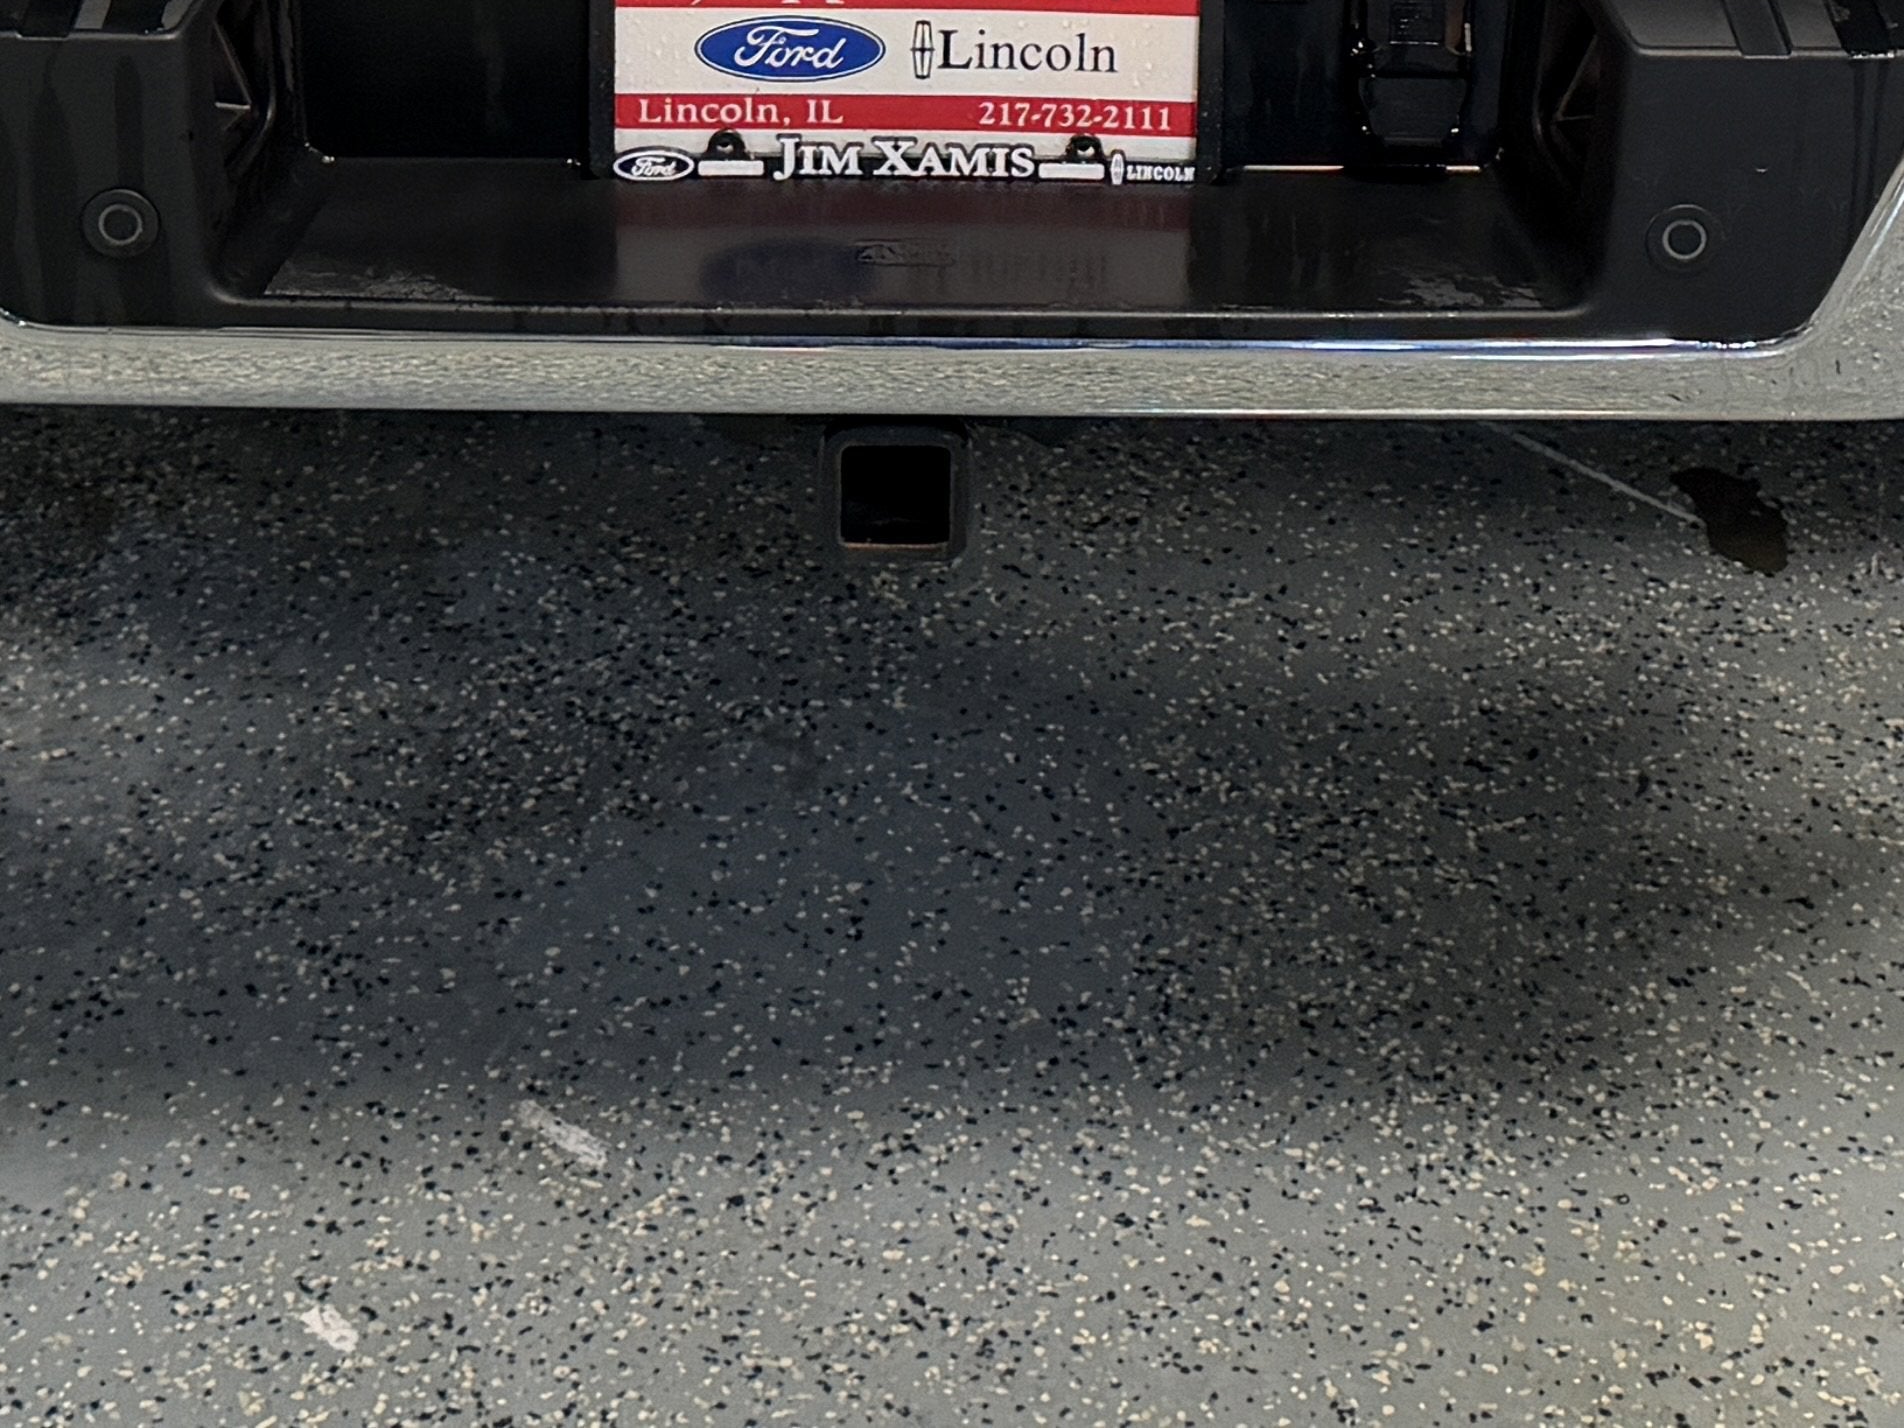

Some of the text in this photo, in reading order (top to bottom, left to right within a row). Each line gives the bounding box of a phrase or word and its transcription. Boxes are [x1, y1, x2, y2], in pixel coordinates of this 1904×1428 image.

[733, 24, 847, 70] Ford
[937, 29, 1119, 74] Lincoln
[638, 97, 845, 127] Lincoln, IL
[977, 101, 1172, 131] 217-732-2111
[630, 156, 678, 178] Ford
[772, 136, 1036, 182] JIM XAMIS
[1126, 164, 1196, 183] LINCOLN
